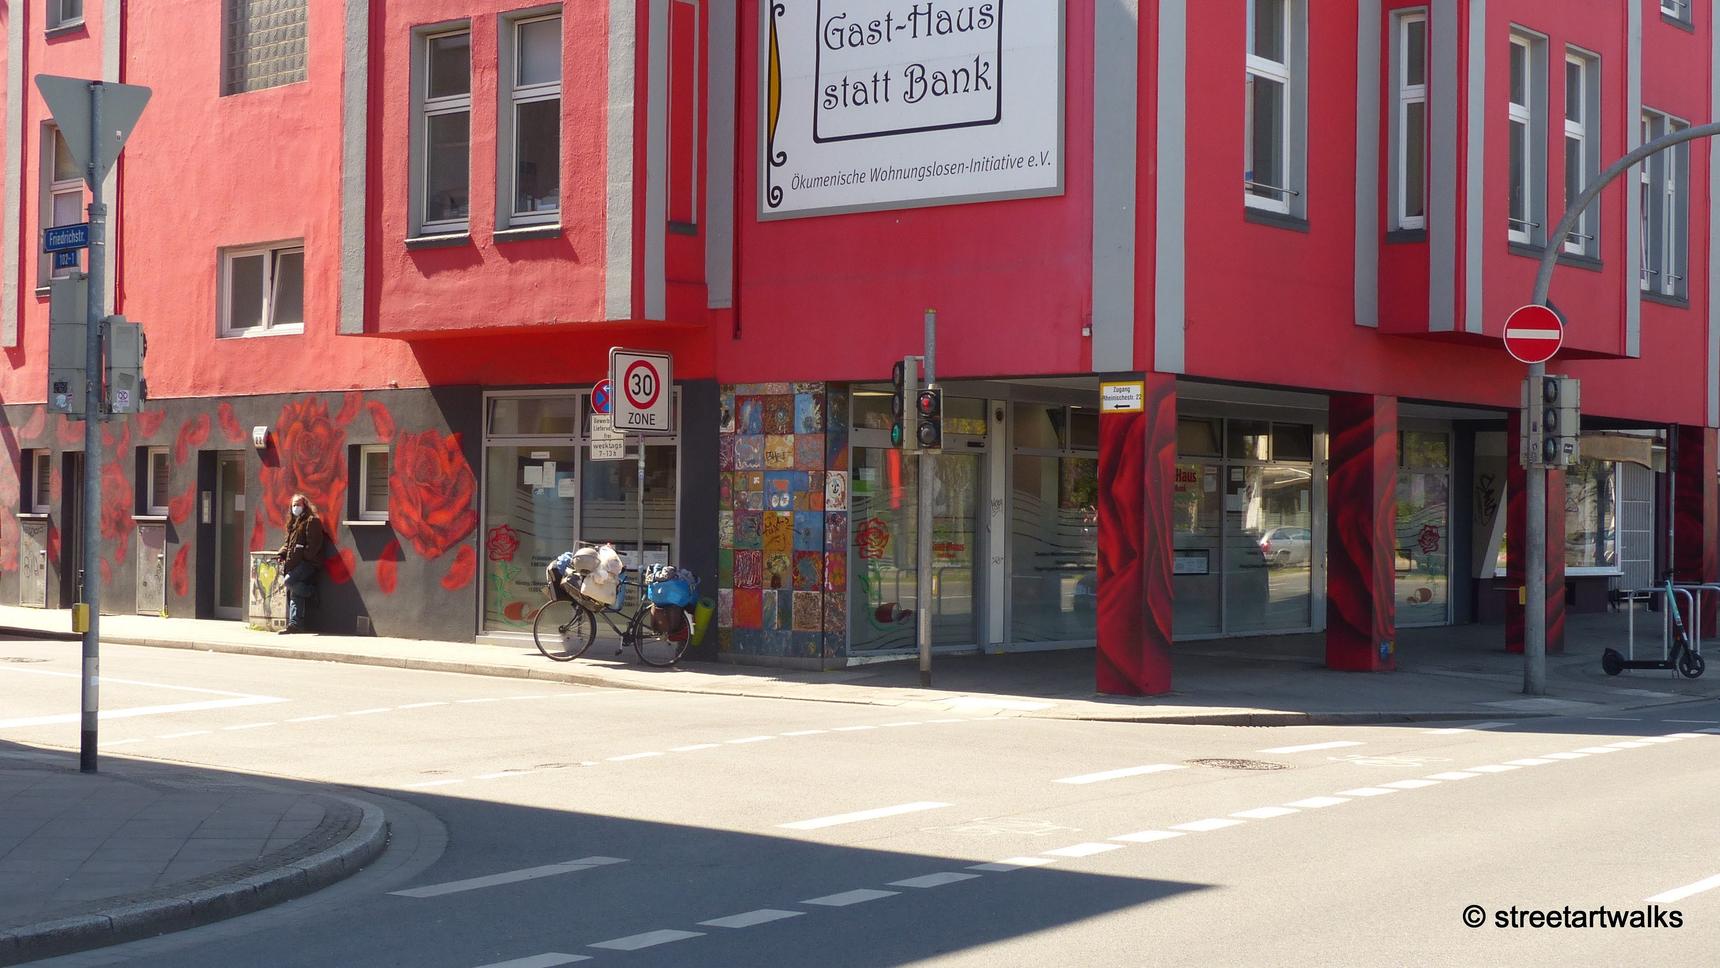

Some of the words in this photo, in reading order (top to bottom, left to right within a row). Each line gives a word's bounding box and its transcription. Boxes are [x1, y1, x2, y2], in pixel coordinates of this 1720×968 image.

[824, 2, 995, 51] Gast-Haus
[823, 70, 892, 110] statt
[903, 54, 992, 104] Bank
[791, 168, 866, 191] Ökumenische
[869, 153, 1024, 183] Wohnungslosen-Initiative
[1027, 151, 1051, 168] e.V.
[50, 230, 85, 246] Friedrichstr.
[632, 373, 652, 396] 30
[628, 412, 656, 426] ZONE
[593, 442, 622, 450] werktags
